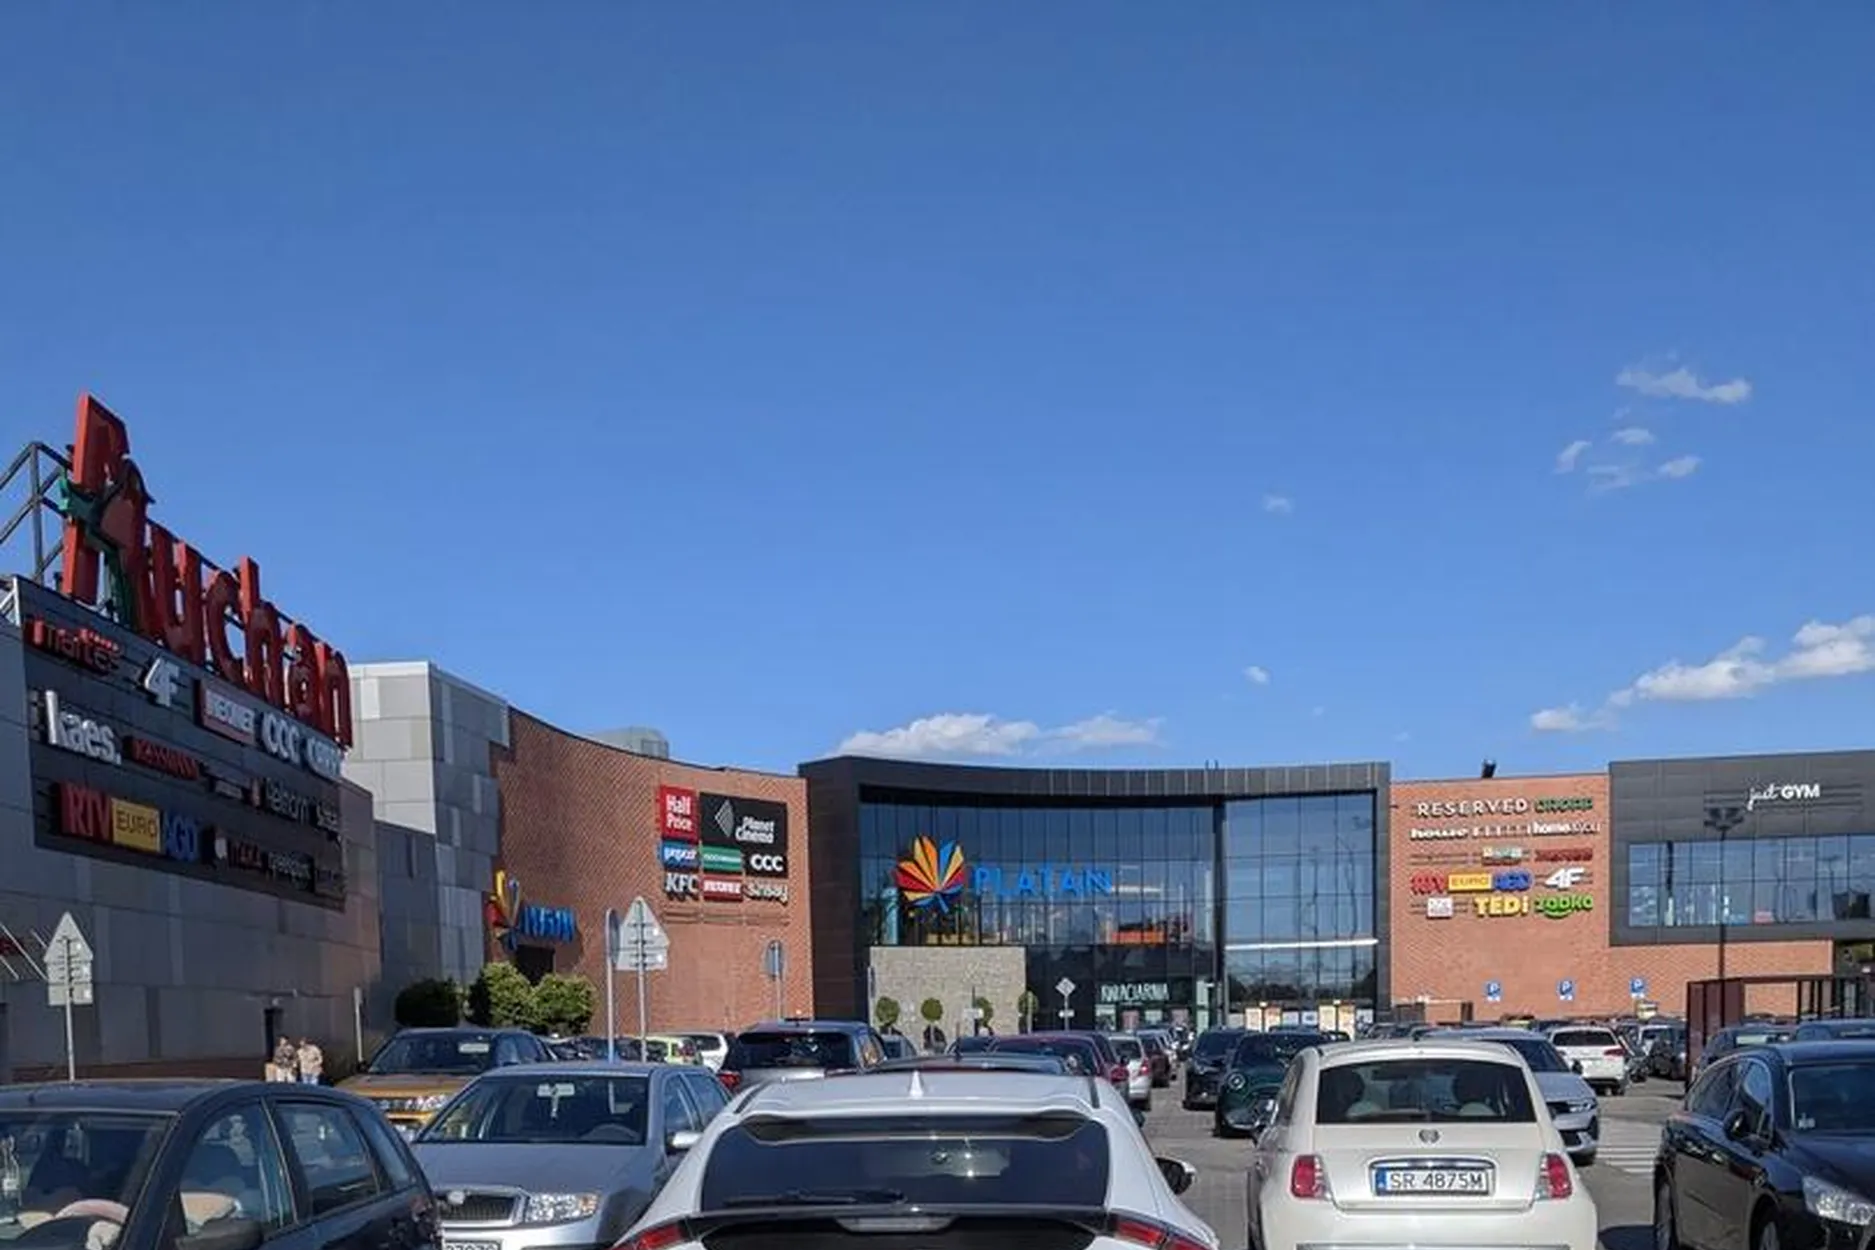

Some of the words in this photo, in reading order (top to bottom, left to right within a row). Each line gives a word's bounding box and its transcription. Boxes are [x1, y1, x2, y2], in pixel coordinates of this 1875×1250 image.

[60, 393, 353, 752] Auchan
[1781, 783, 1820, 800] GYM
[1417, 798, 1528, 818] RESERVED
[750, 853, 784, 872] CCC
[664, 872, 700, 893] KFC
[974, 866, 1113, 897] PLATAN
[1543, 867, 1586, 889] 4F
[1473, 895, 1530, 916] TEDi
[1390, 1173, 1415, 1189] SR
[1423, 1173, 1483, 1189] 4875M
